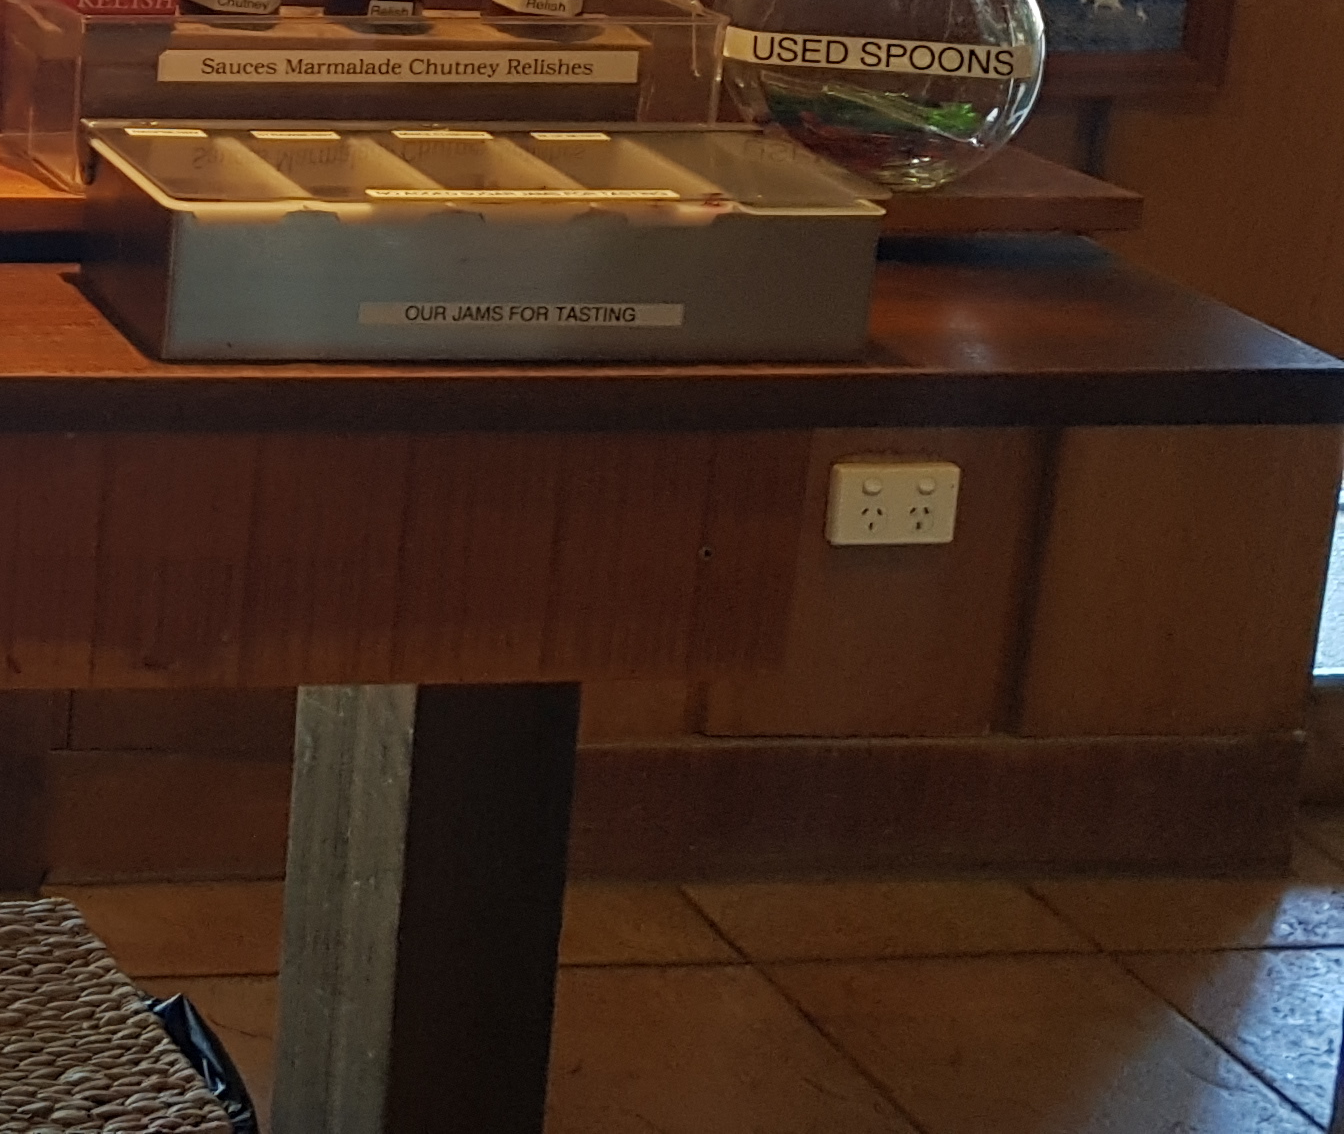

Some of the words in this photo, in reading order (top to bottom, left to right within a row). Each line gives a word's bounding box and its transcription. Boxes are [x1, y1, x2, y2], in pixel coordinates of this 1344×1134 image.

[371, 5, 409, 16] Relish
[752, 35, 849, 65] USED
[859, 40, 1016, 77] SPOONS
[201, 58, 278, 76] Sauces
[285, 58, 402, 76] Marmalade
[408, 58, 499, 78] Chutney
[505, 58, 594, 76] Relishes
[405, 305, 446, 321] OUR
[452, 305, 503, 322] JAMS
[508, 306, 549, 322] FOR
[555, 306, 636, 323] TASTING
